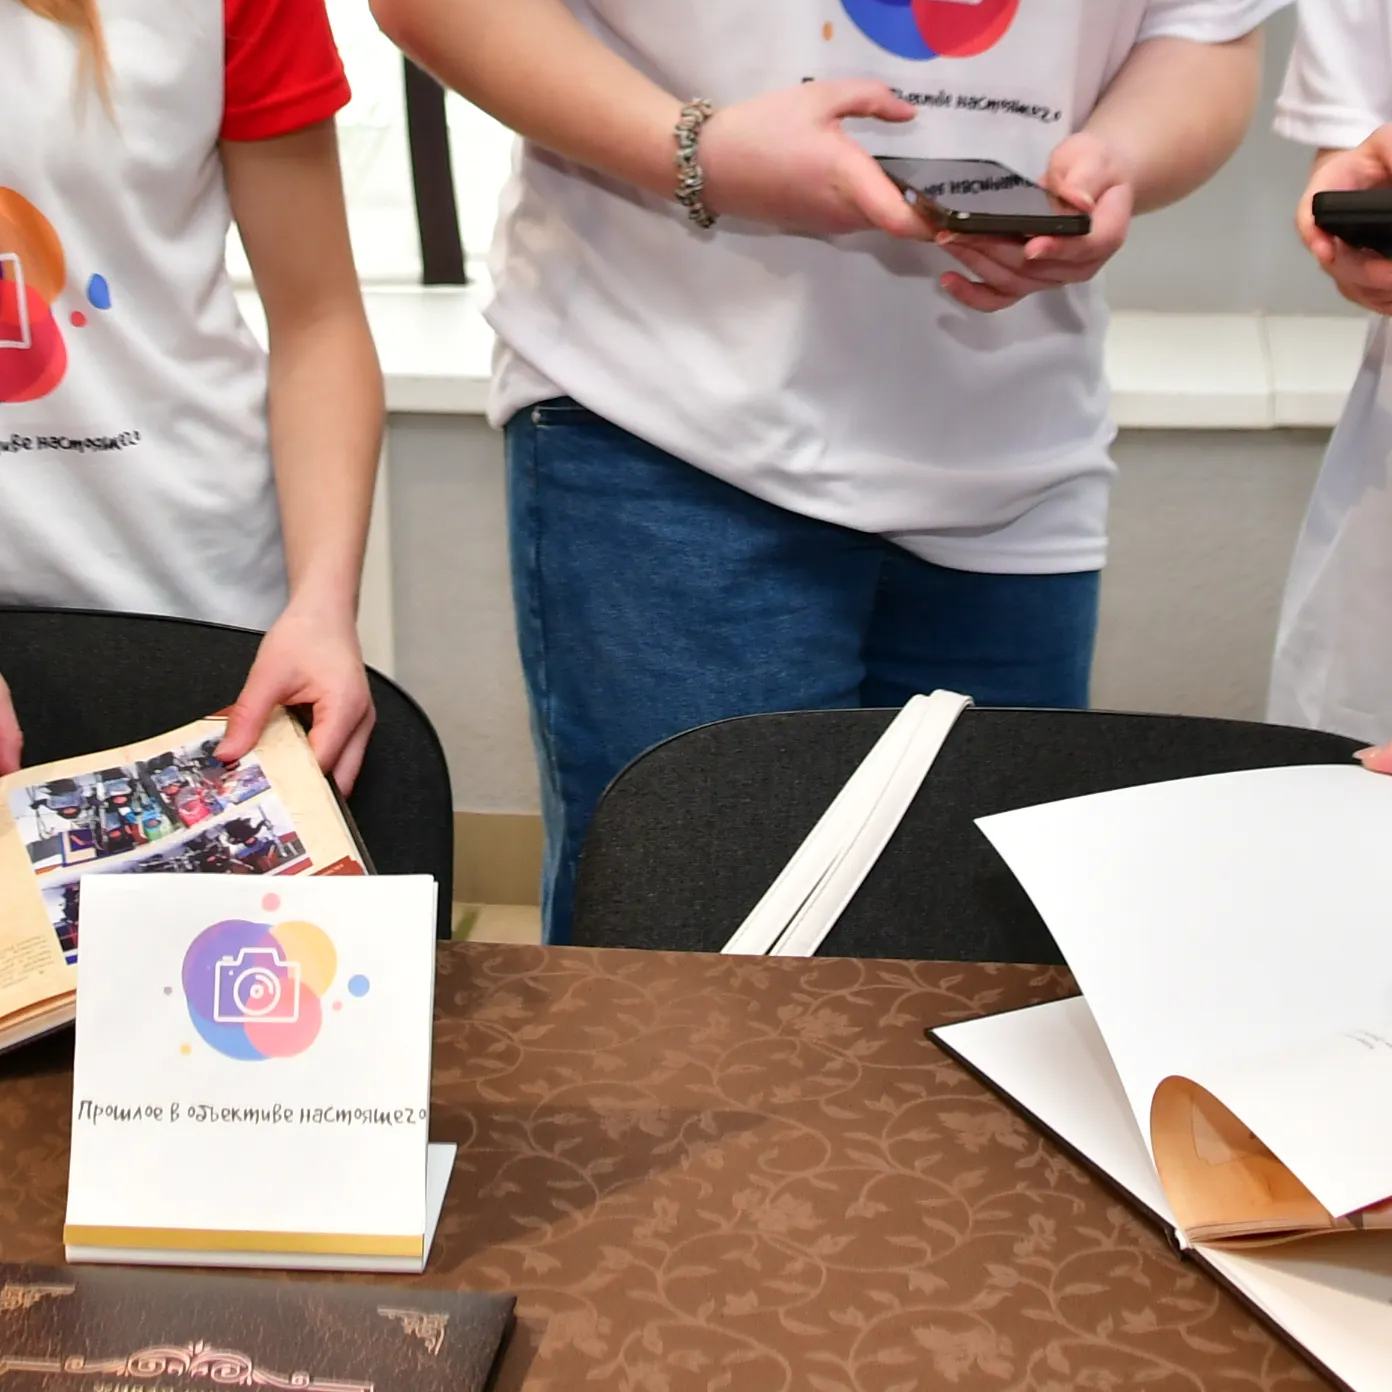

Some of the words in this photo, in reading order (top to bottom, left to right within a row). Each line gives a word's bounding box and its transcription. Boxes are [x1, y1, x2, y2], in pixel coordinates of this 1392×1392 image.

[77, 1099, 164, 1126] Прошлое
[169, 1101, 181, 1123] в
[187, 1103, 294, 1126] объективе
[299, 1106, 427, 1127] настоящего
